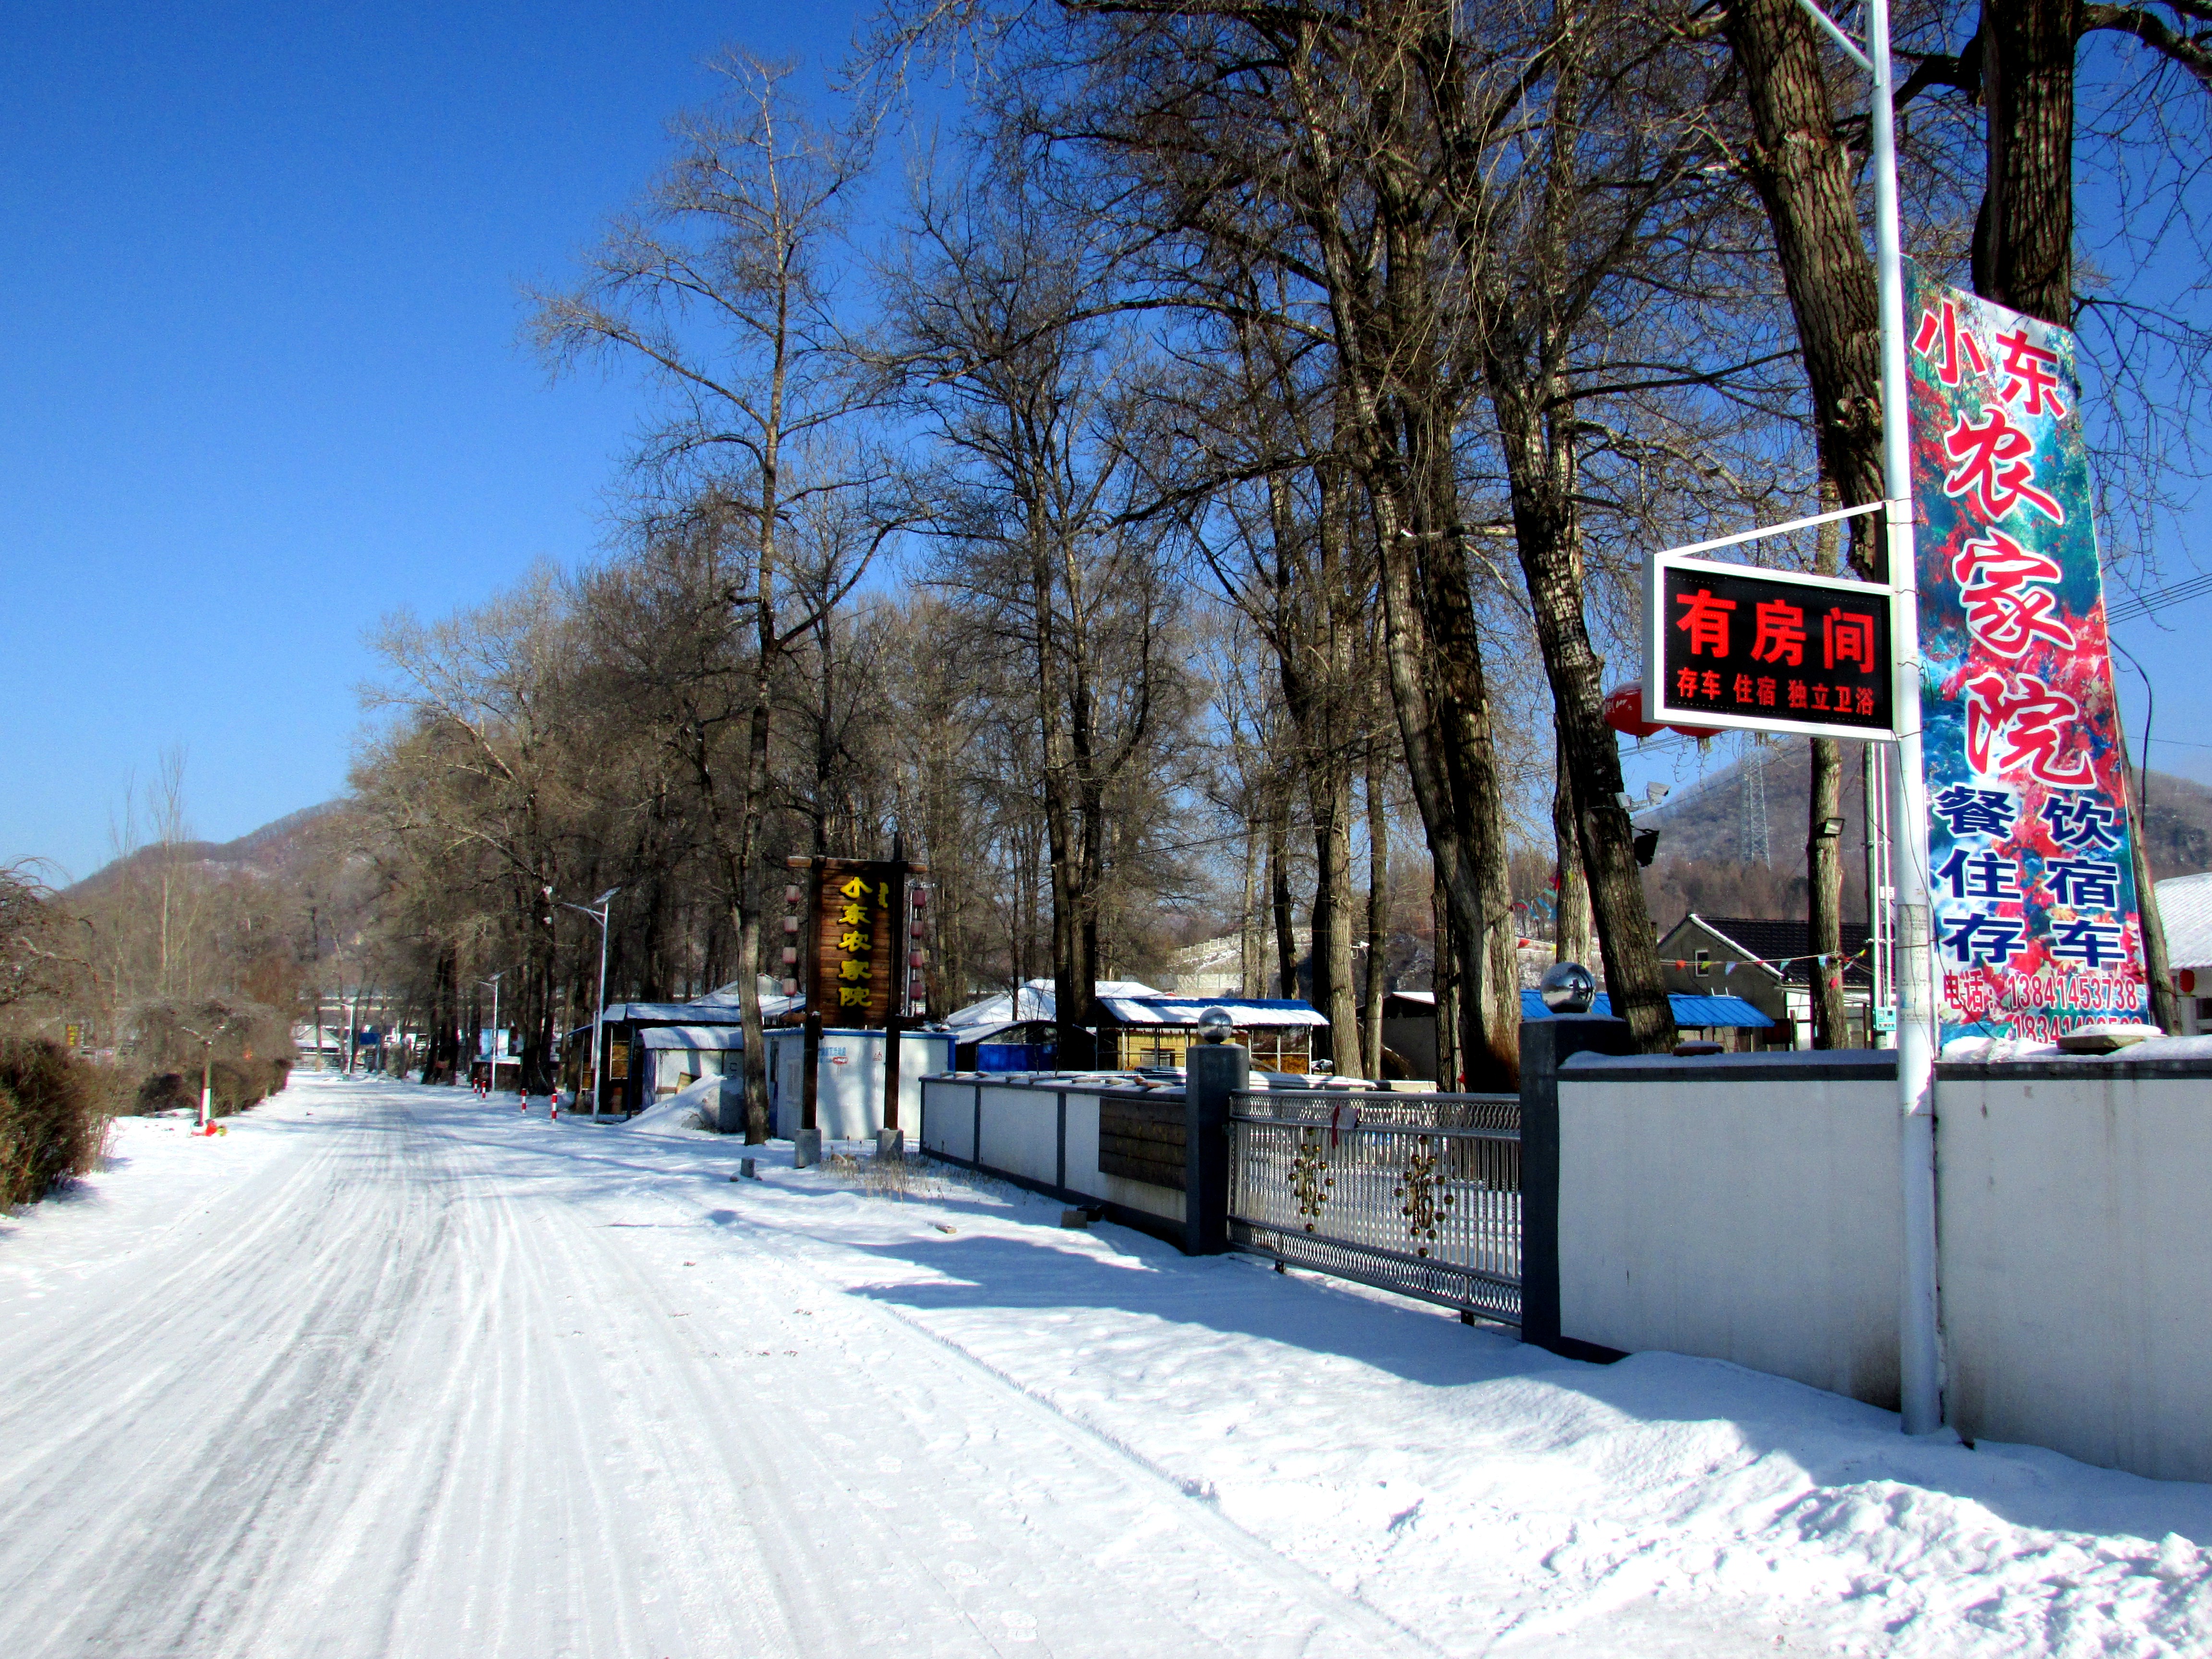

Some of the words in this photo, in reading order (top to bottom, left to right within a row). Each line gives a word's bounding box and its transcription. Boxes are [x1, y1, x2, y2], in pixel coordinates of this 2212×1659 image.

[1912, 298, 2066, 420] 小东
[1944, 404, 2097, 790] 农家院
[1676, 589, 1875, 673] 有房间
[1677, 667, 1722, 700] 存车
[1733, 673, 1776, 706] 住宿
[1788, 680, 1875, 716] 独立卫浴
[1933, 782, 2119, 850] 餐饮
[1936, 846, 2120, 910] 住宿
[1942, 913, 2127, 968] 存车
[2007, 974, 2138, 1010] 13841453738
